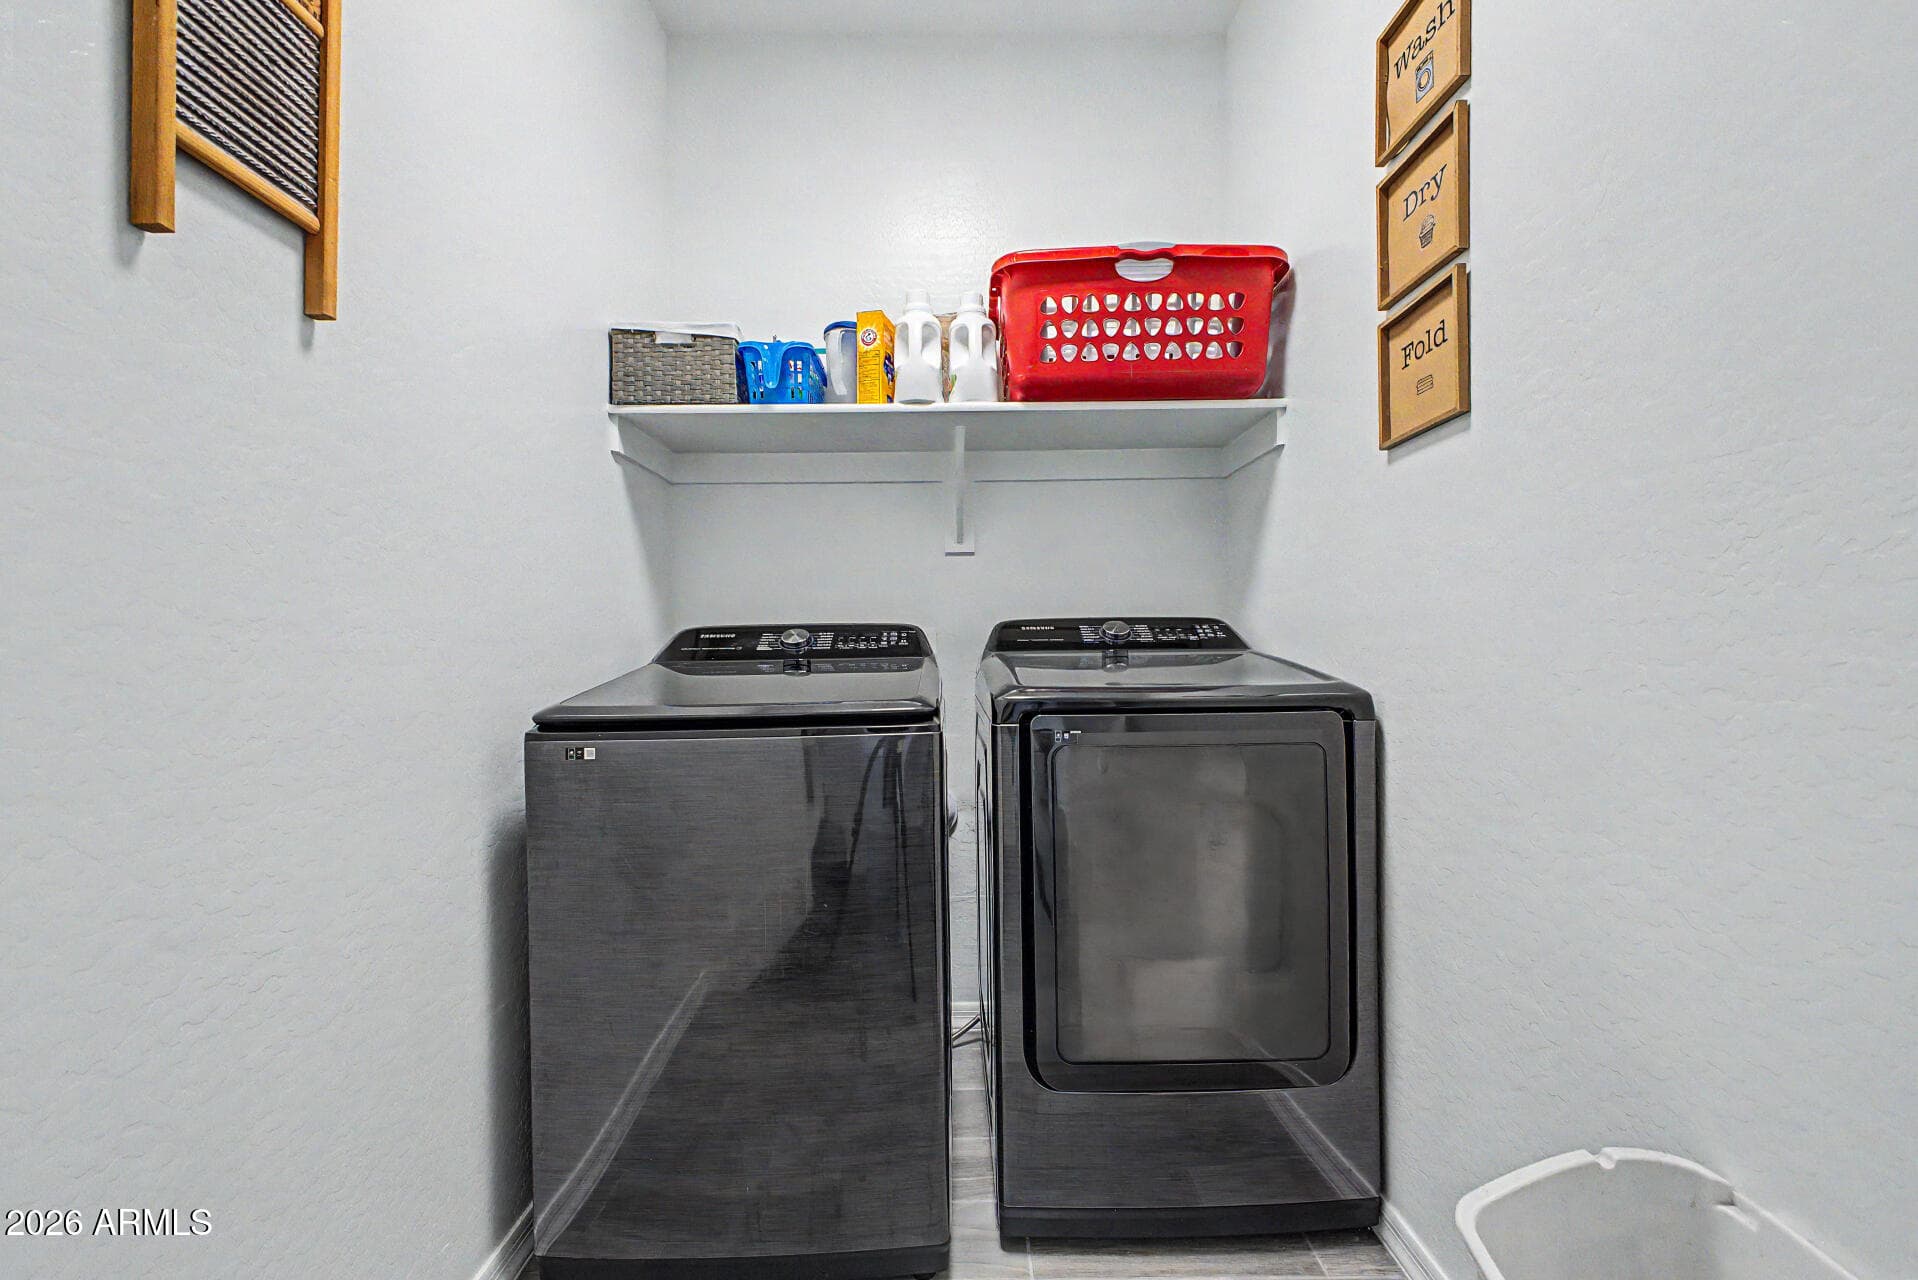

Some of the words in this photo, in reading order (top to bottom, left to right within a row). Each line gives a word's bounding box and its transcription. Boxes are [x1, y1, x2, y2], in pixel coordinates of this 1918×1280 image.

[1394, 0, 1456, 80] Wash
[1402, 164, 1448, 222] Dry
[1401, 319, 1448, 370] Fold
